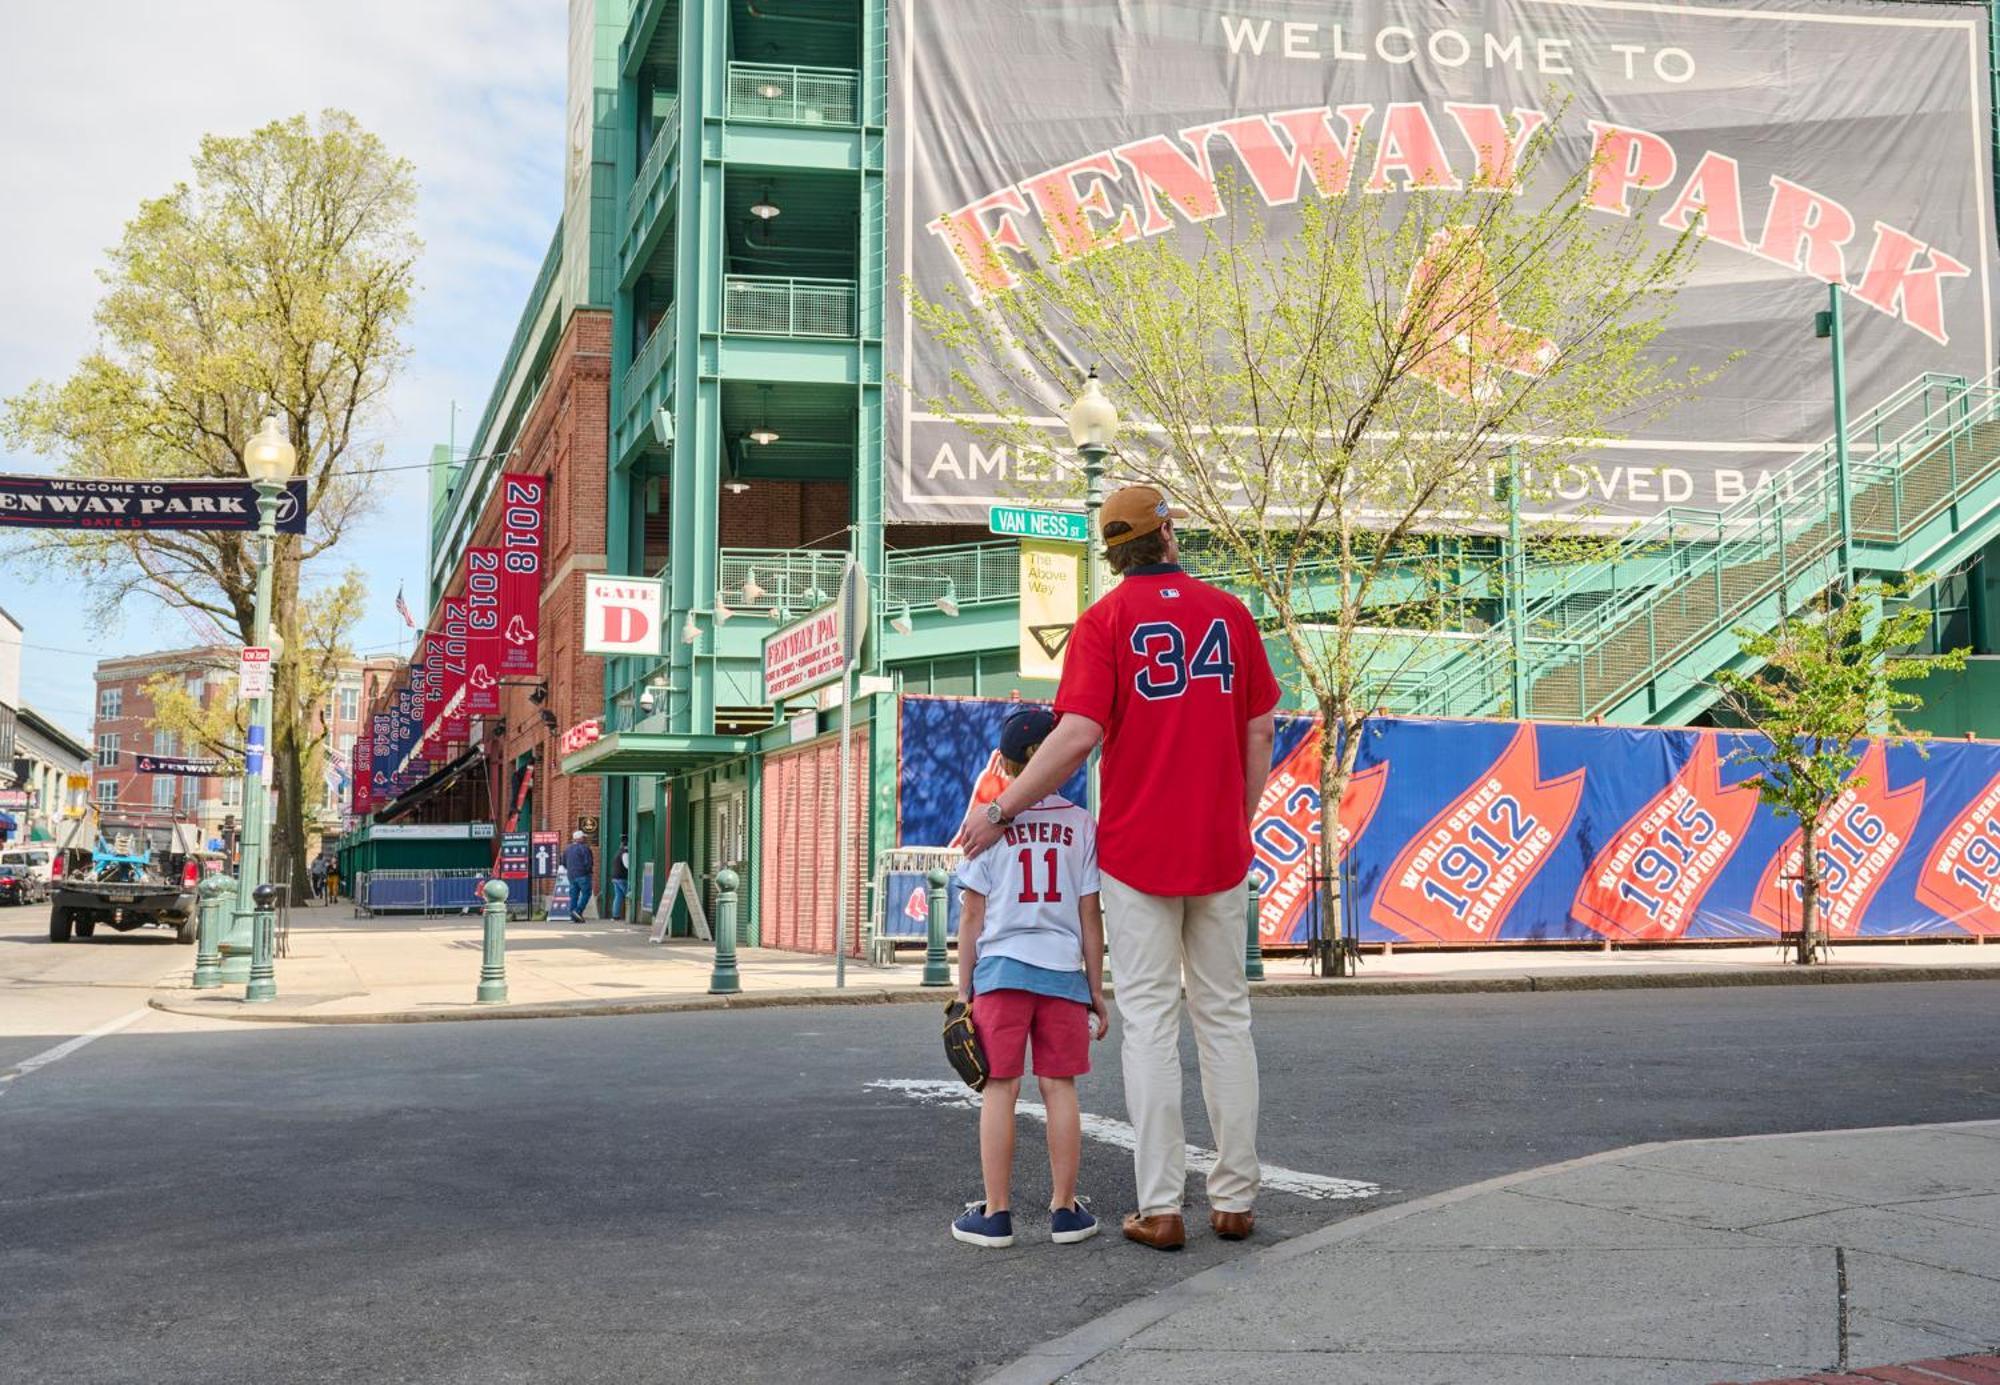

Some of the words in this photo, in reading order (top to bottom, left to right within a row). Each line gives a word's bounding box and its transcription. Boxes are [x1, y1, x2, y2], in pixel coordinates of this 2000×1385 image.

[1221, 15, 1573, 76] WELCOME
[1611, 44, 1696, 84] TO
[926, 101, 1550, 307] FENWAY
[1580, 119, 1972, 347] PARK
[50, 481, 135, 494] WELCOME
[142, 485, 164, 495] TO
[82, 518, 122, 527] GATE
[131, 518, 142, 528] D
[139, 496, 247, 514] PARK
[998, 510, 1026, 532] VAN
[1030, 513, 1069, 537] NESS
[1070, 526, 1080, 537] ST
[505, 481, 541, 574] 2018
[468, 551, 498, 631] 2013
[595, 586, 655, 601] GATE
[602, 605, 650, 644] D
[444, 603, 467, 676] 2007
[1130, 618, 1236, 701] 34
[1003, 821, 1074, 847] DEVERS
[1400, 828, 1453, 892] WORLD
[1447, 778, 1504, 832] SERIES
[1421, 794, 1537, 920] 1912
[1597, 832, 1646, 892] WORLD
[1640, 783, 1690, 834] SERIES
[1617, 795, 1717, 922] 1915
[1936, 821, 1976, 875] WORLD
[1018, 848, 1062, 904] 11
[1465, 825, 1554, 935] CHAMPIONS
[1659, 828, 1733, 933] CHAMPIONS
[1830, 832, 1901, 931] CHAMPIONS
